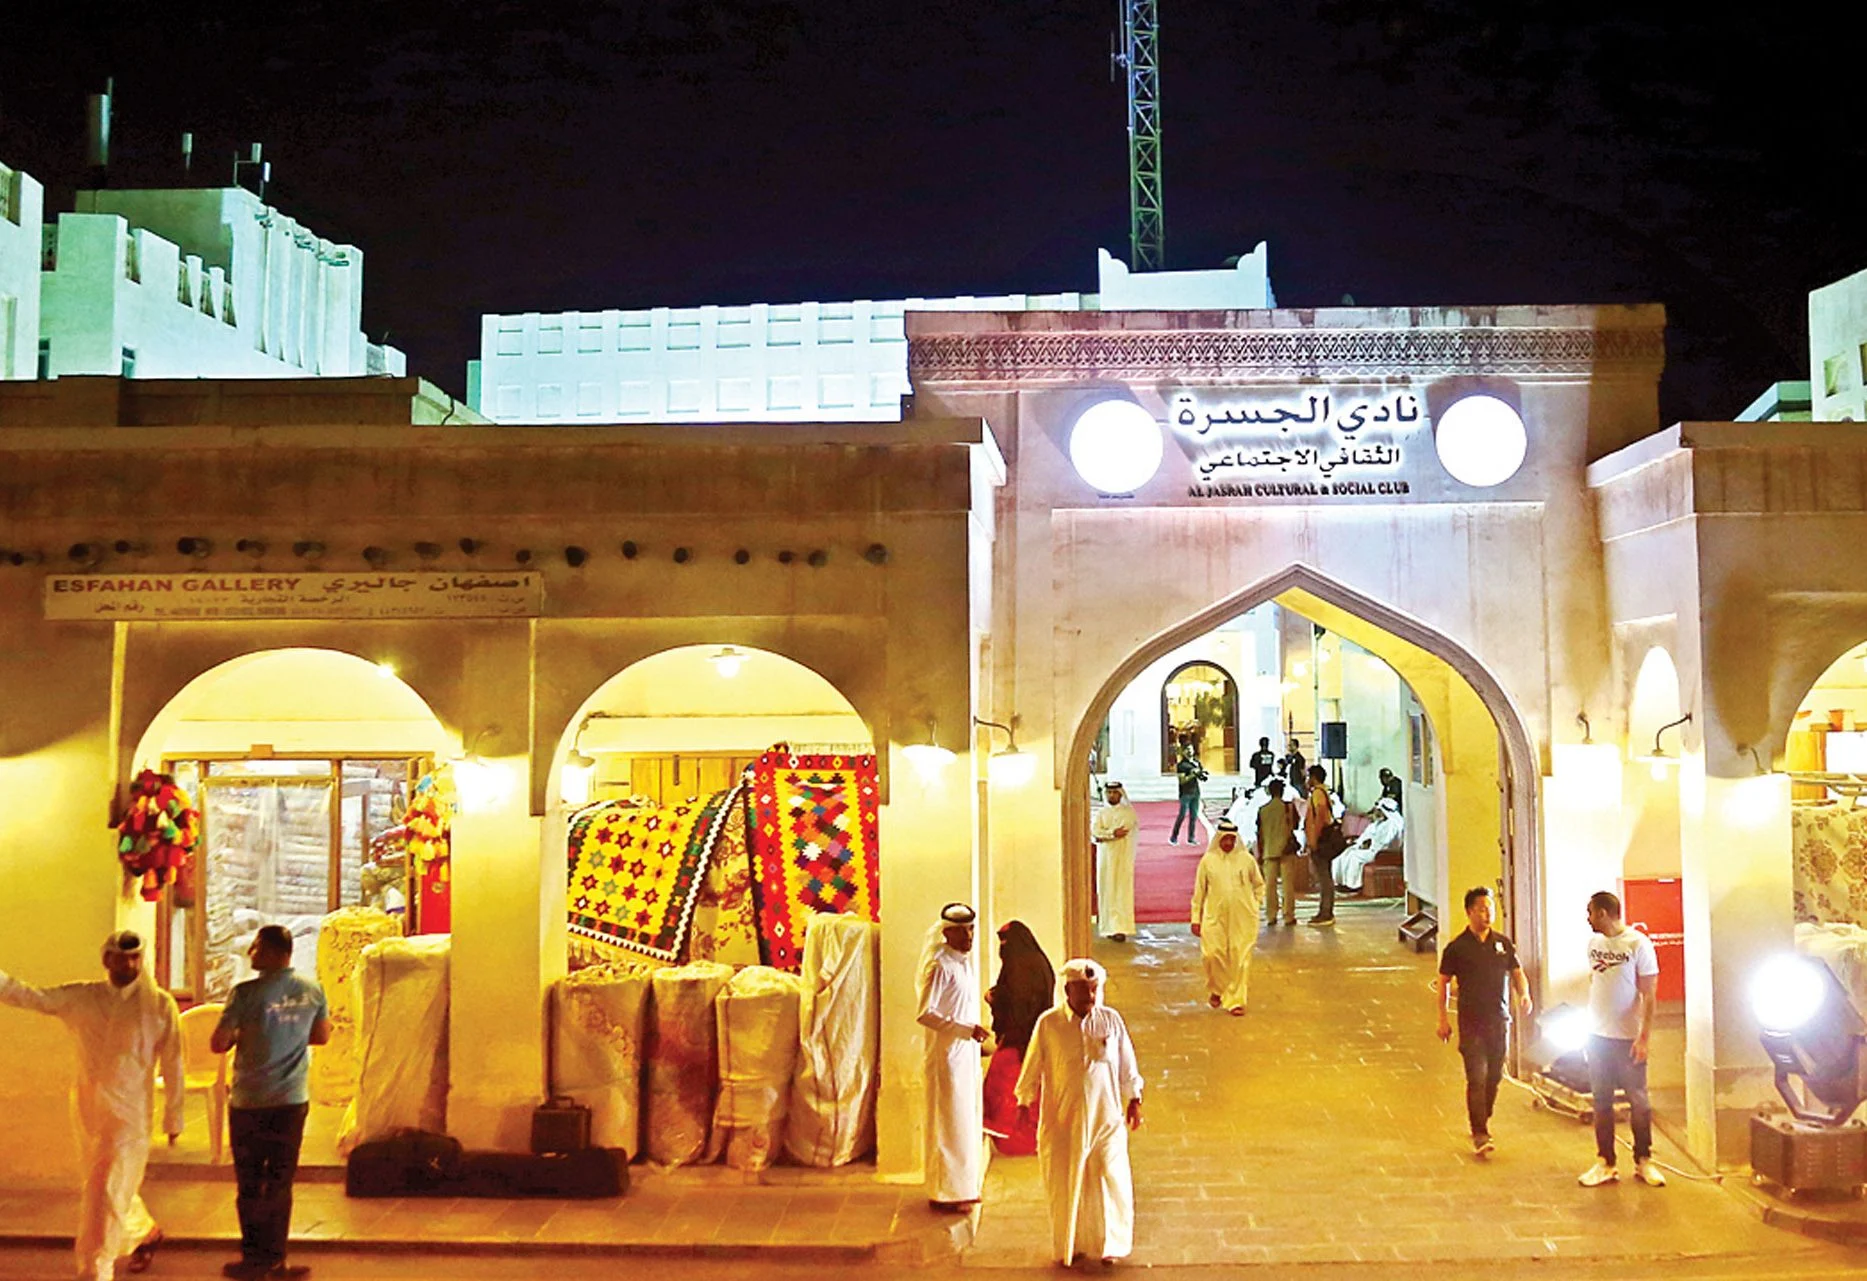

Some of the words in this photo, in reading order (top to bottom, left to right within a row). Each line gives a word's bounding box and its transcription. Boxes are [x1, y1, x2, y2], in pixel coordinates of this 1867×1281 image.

[1178, 395, 1330, 435] الجسرة
[1336, 396, 1418, 440] نادي
[1199, 449, 1318, 481] الاجتماعي
[1319, 445, 1400, 478] الثقافي
[1187, 484, 1204, 497] AL
[1203, 482, 1252, 498] JASRAH
[1254, 481, 1318, 496] CULTURAL
[1332, 481, 1376, 495] SOCIAL
[1378, 481, 1410, 495] CLUB
[54, 579, 173, 593] ESFAHAN
[182, 577, 301, 592] GALLERY
[322, 577, 417, 593] جاليري
